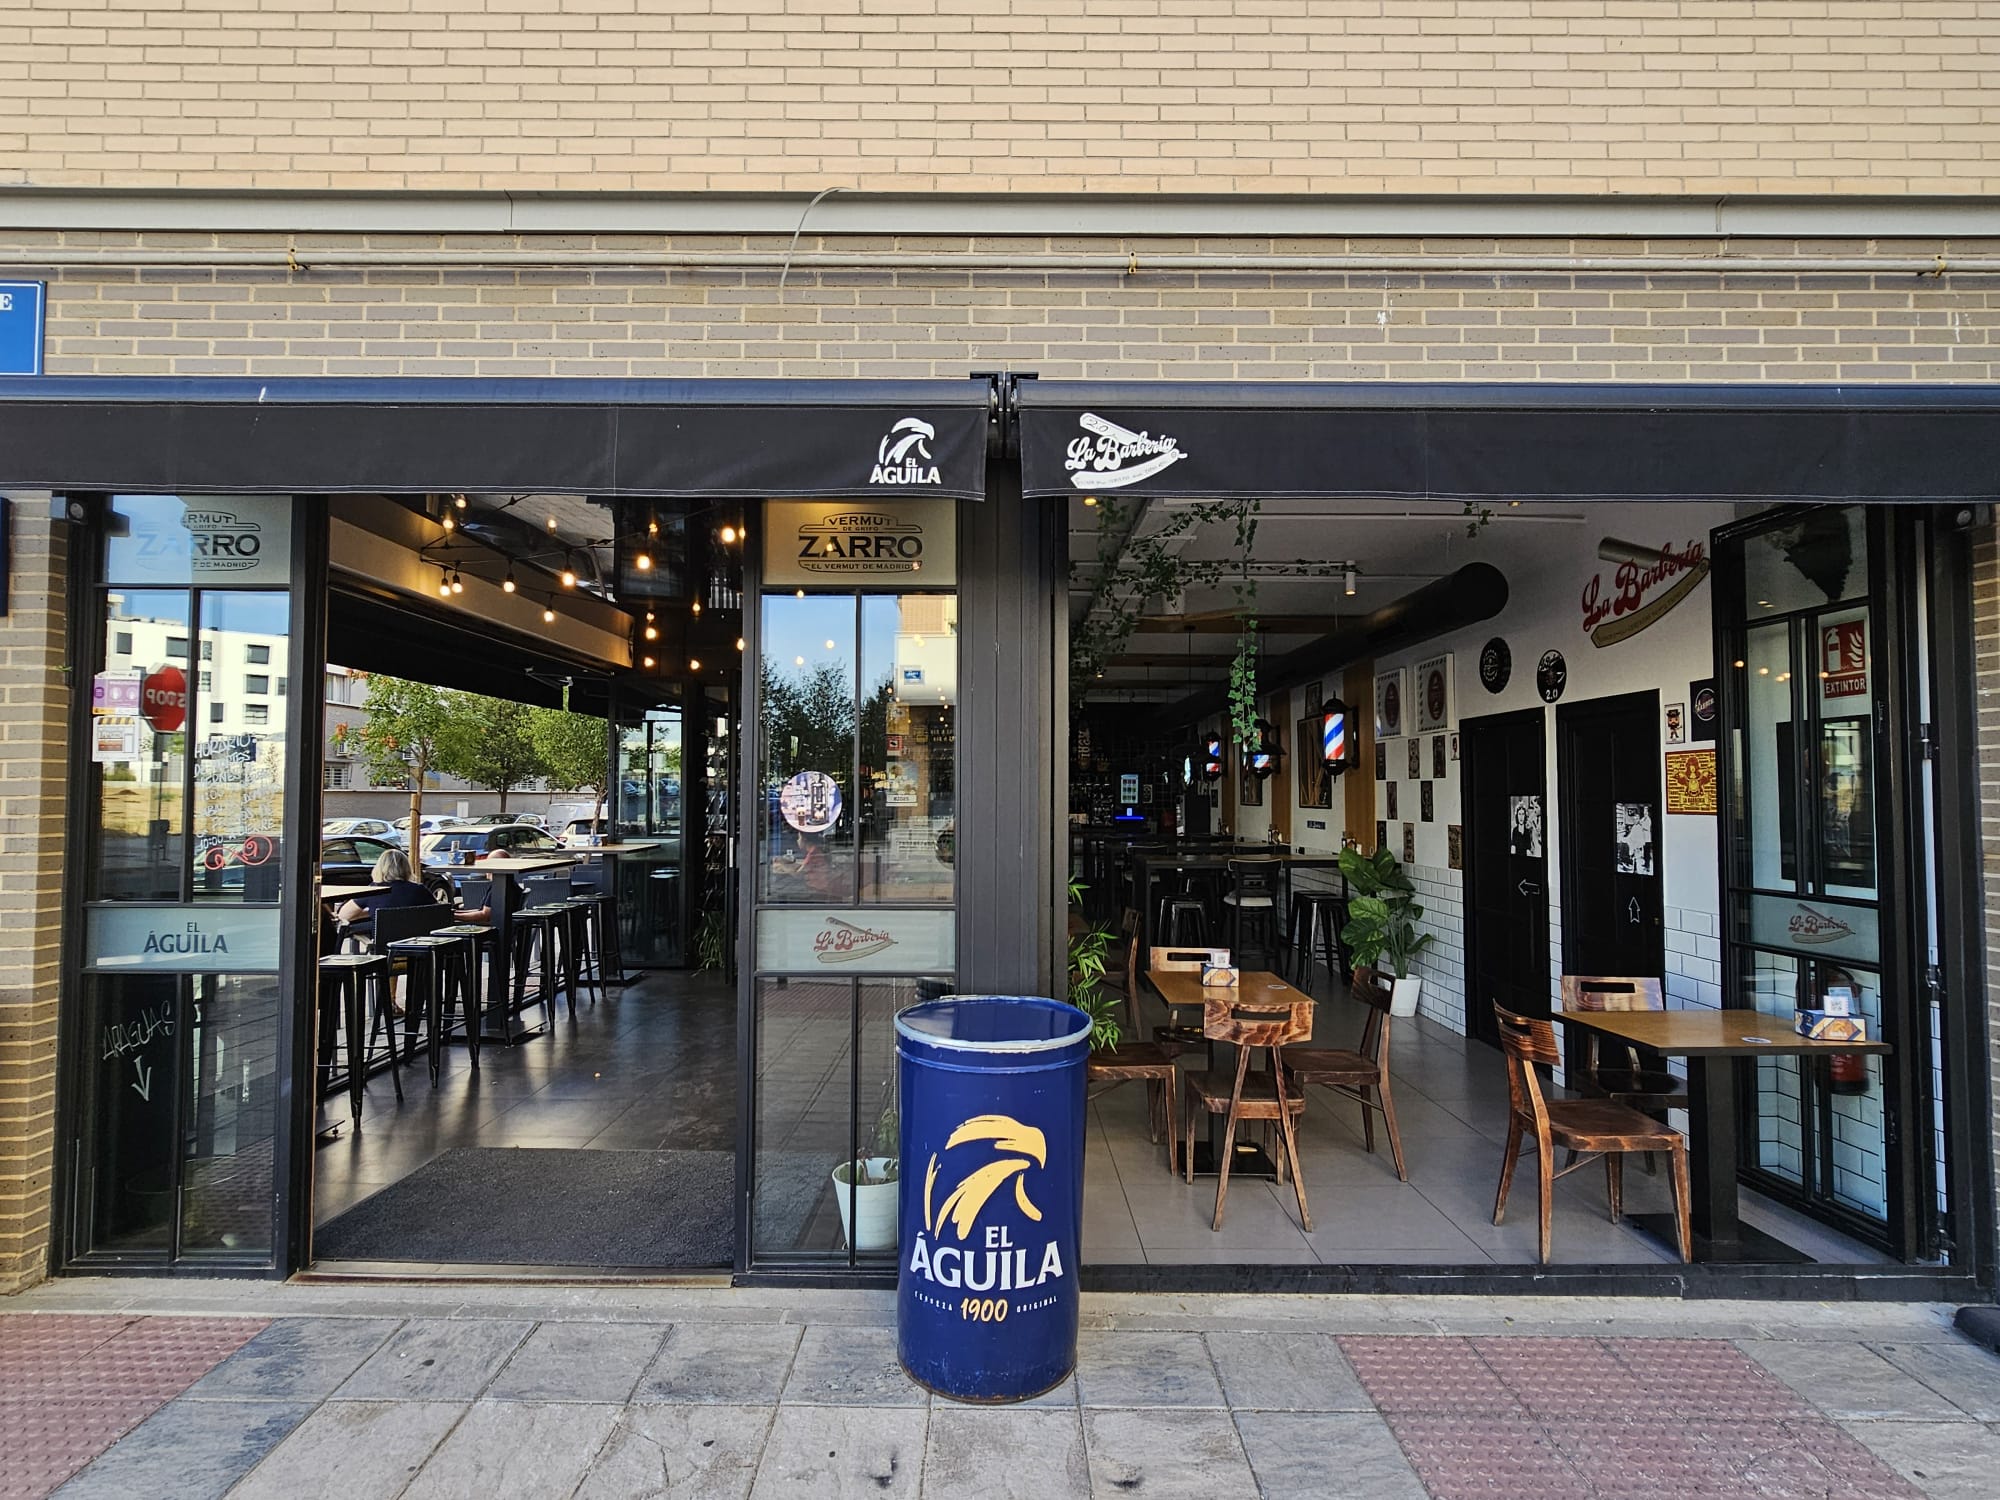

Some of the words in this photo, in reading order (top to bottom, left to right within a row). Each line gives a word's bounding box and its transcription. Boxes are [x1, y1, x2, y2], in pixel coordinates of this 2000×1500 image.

[1086, 419, 1109, 432] 2.0
[1065, 437, 1096, 470] La
[1093, 430, 1177, 471] Barbería
[905, 457, 919, 468] EL
[869, 464, 942, 484] ÁGUILA
[829, 515, 892, 526] VERMUT
[798, 535, 923, 558] ZARRO
[1582, 574, 1611, 633] La
[1613, 539, 1706, 616] Barbería
[1545, 689, 1559, 700] 2.0
[1825, 678, 1866, 694] EXTINTOR
[187, 922, 200, 933] EL
[144, 931, 228, 954] ÁGUILA
[814, 930, 834, 952] La
[985, 1226, 1014, 1249] EL
[910, 1231, 1064, 1292] ÁGUILA
[960, 1297, 1009, 1322] 1900
[1017, 1295, 1057, 1313] ORIGINAL
